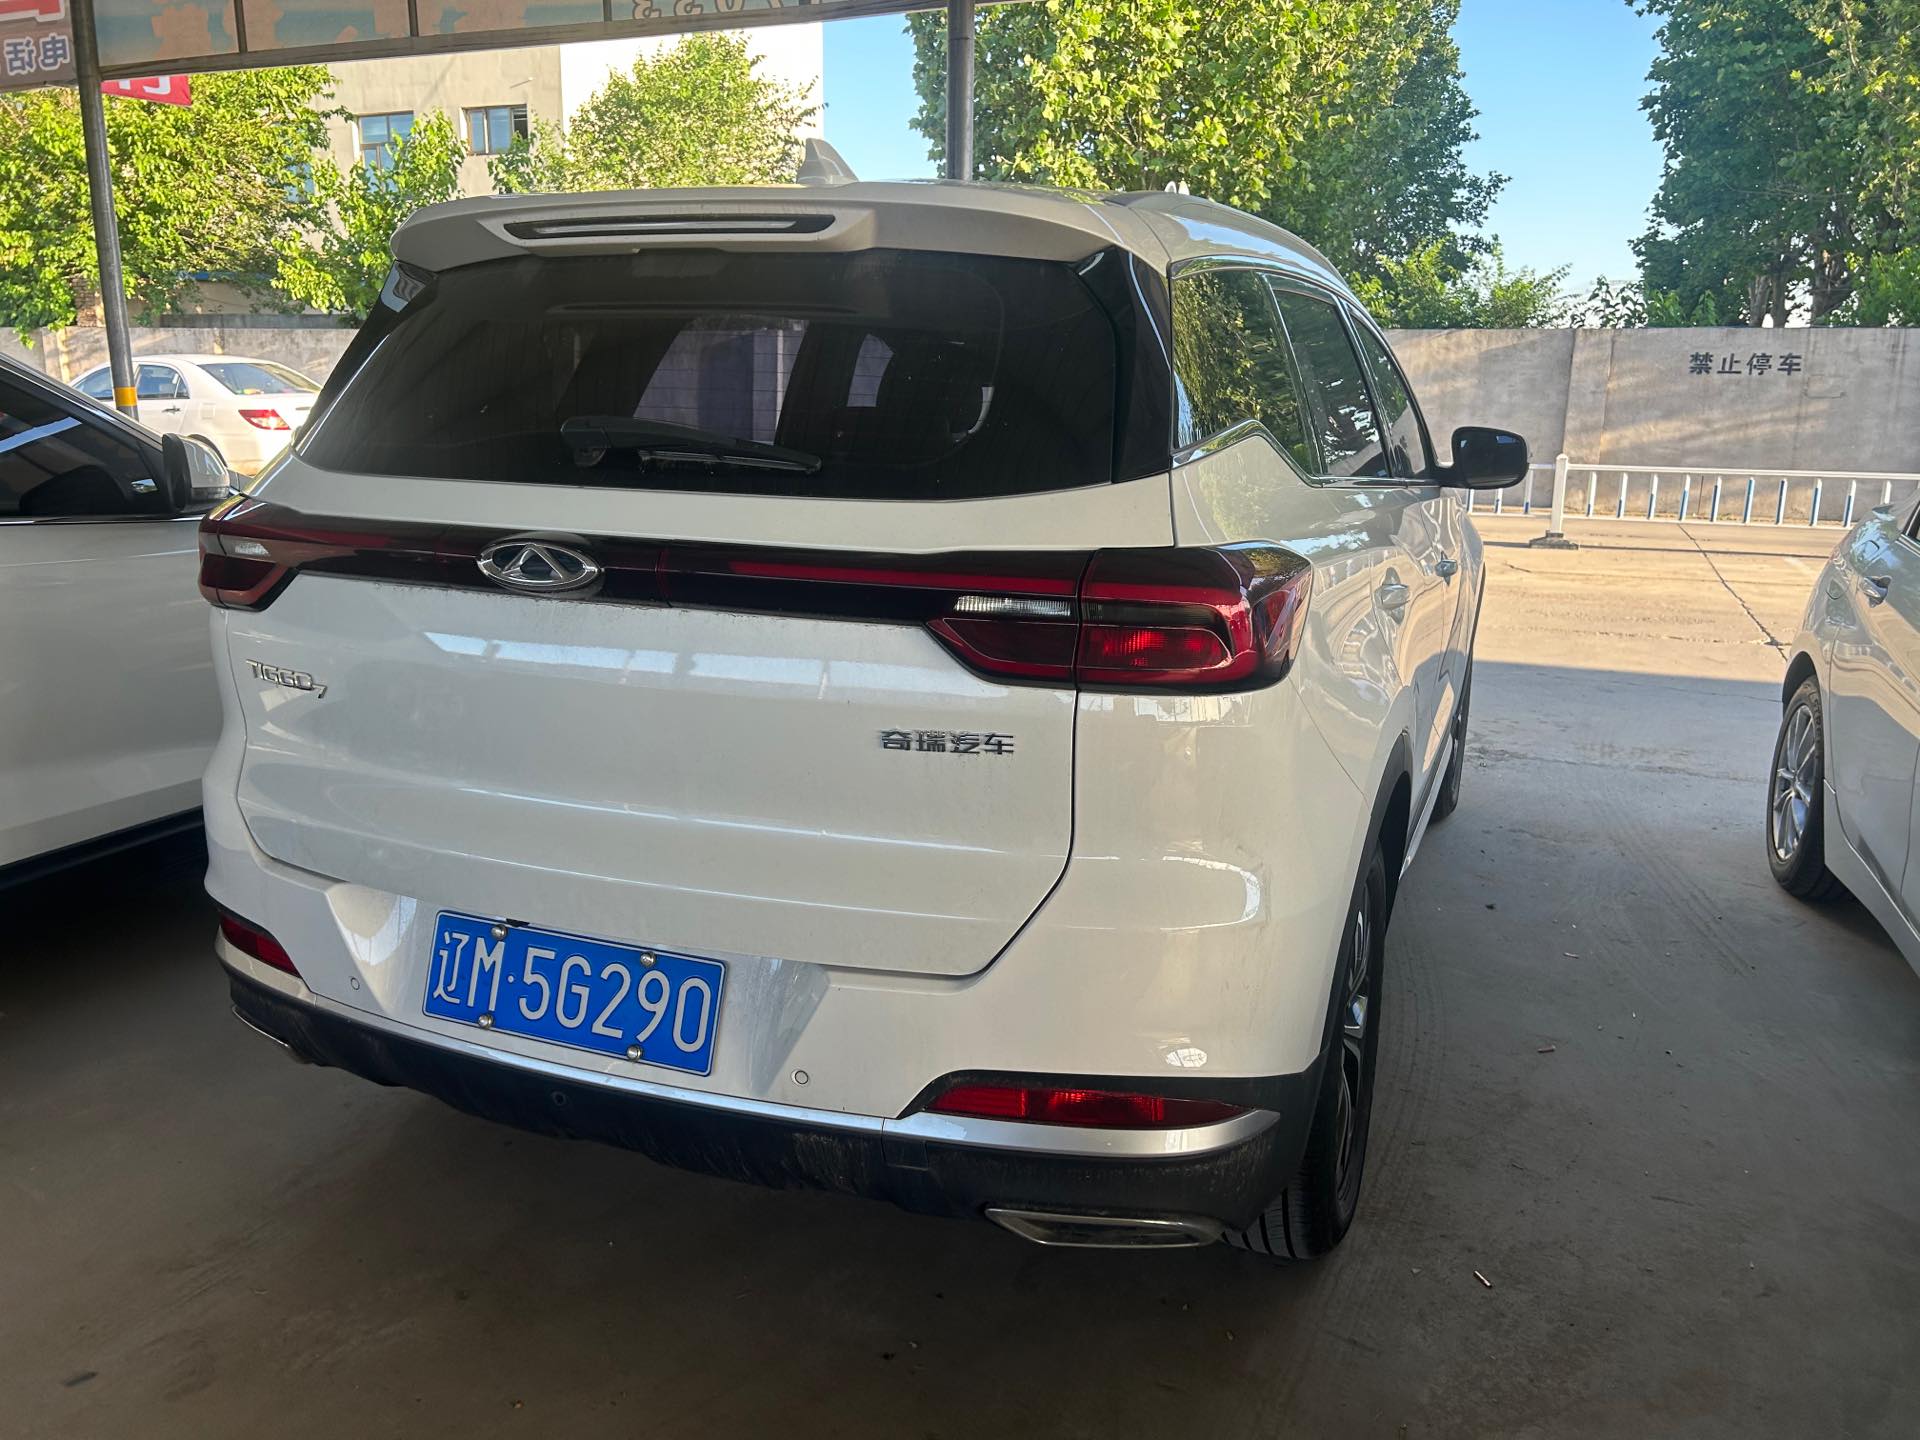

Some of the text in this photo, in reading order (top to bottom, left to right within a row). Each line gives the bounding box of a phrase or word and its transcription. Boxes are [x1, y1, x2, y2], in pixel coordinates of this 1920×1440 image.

[1689, 352, 1802, 376] 禁止停车
[880, 729, 1014, 755] 奇瑞汽车
